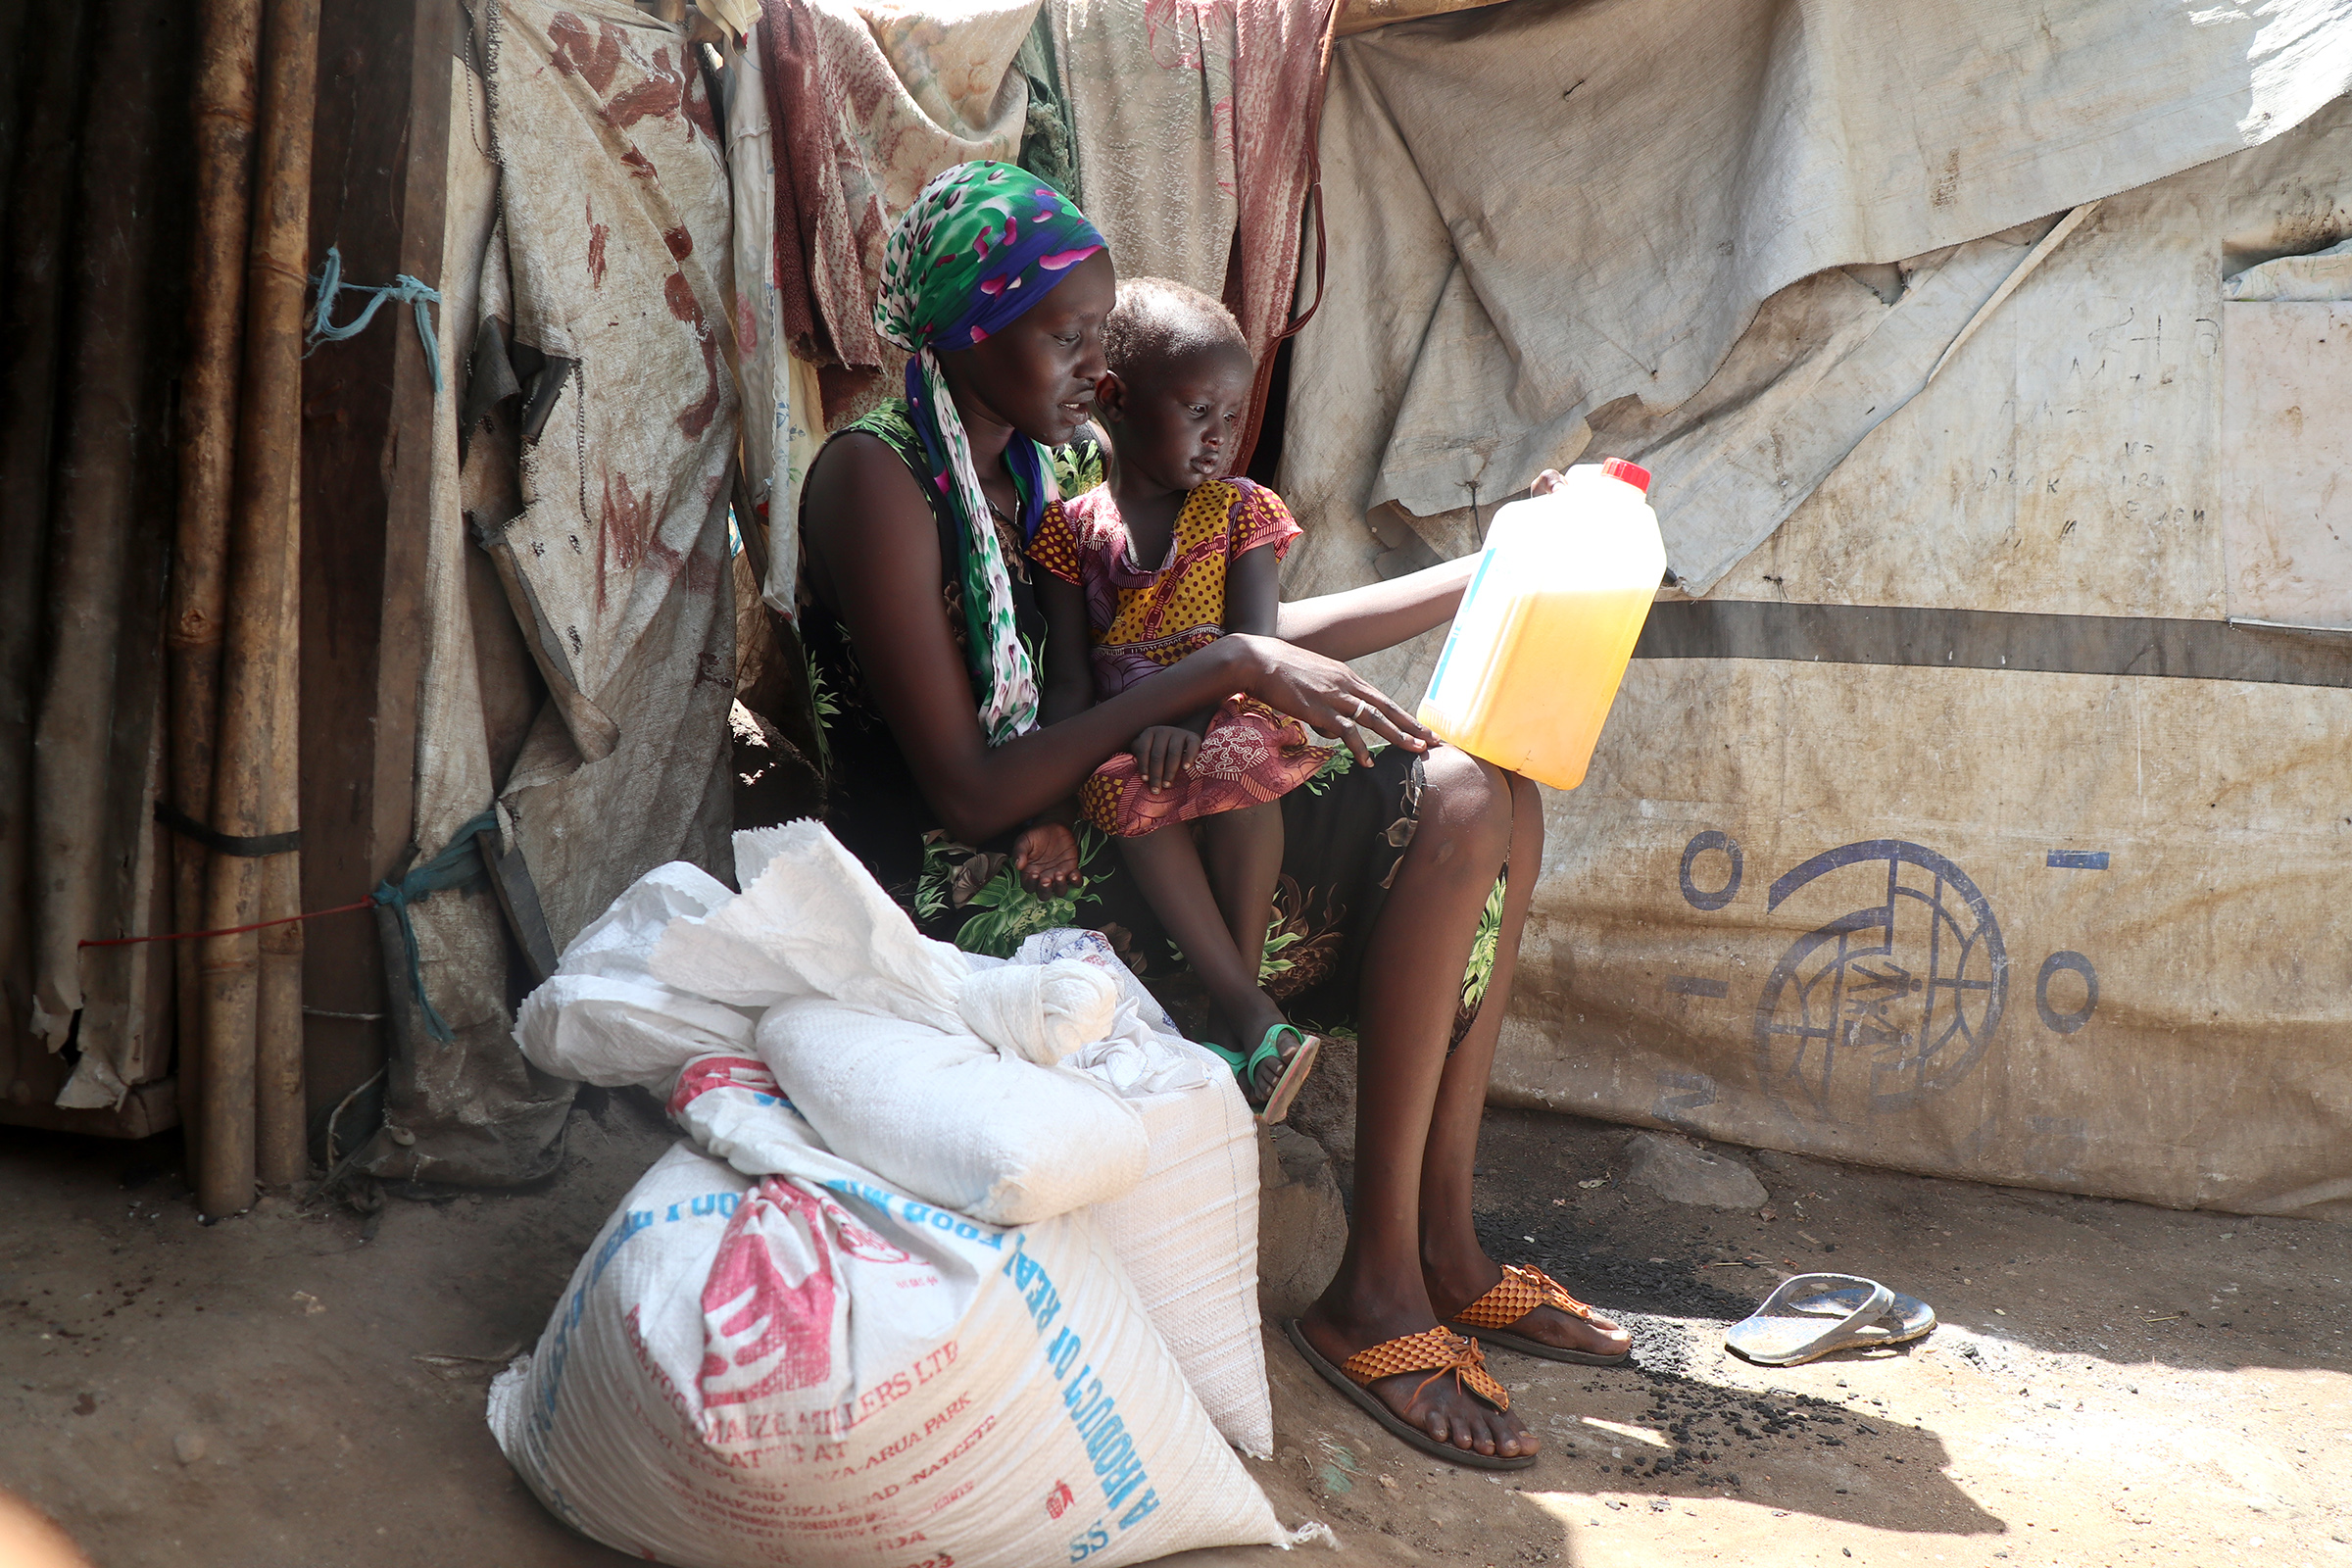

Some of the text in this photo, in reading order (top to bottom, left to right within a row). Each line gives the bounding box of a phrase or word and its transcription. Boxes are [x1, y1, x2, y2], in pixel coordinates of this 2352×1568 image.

[903, 1201, 1004, 1251] FOOD
[705, 1410, 792, 1446] MAIZE
[911, 1339, 958, 1386] LTD
[923, 1390, 972, 1438] PARK
[812, 1440, 849, 1464] AT
[837, 1484, 901, 1513] RAD
[1118, 1485, 1159, 1530] A
